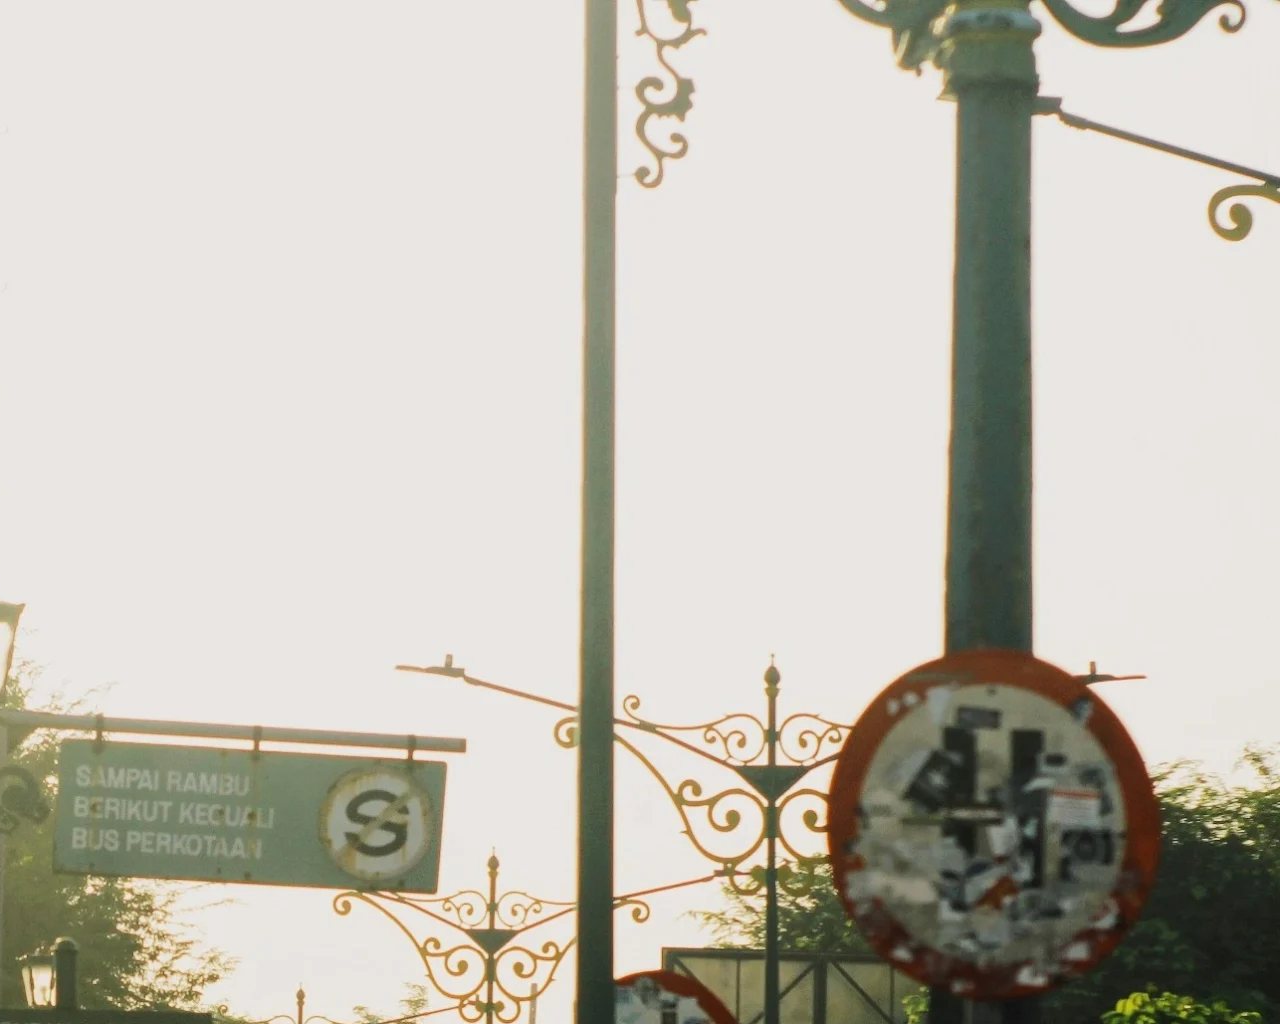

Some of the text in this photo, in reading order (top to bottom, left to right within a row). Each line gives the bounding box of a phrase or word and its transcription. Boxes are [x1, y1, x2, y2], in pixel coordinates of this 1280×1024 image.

[75, 765, 250, 796] SAMPAI RAMBU
[73, 796, 275, 829] BERIKUT KECUALI
[73, 827, 263, 859] BUS PERKOTAAN
